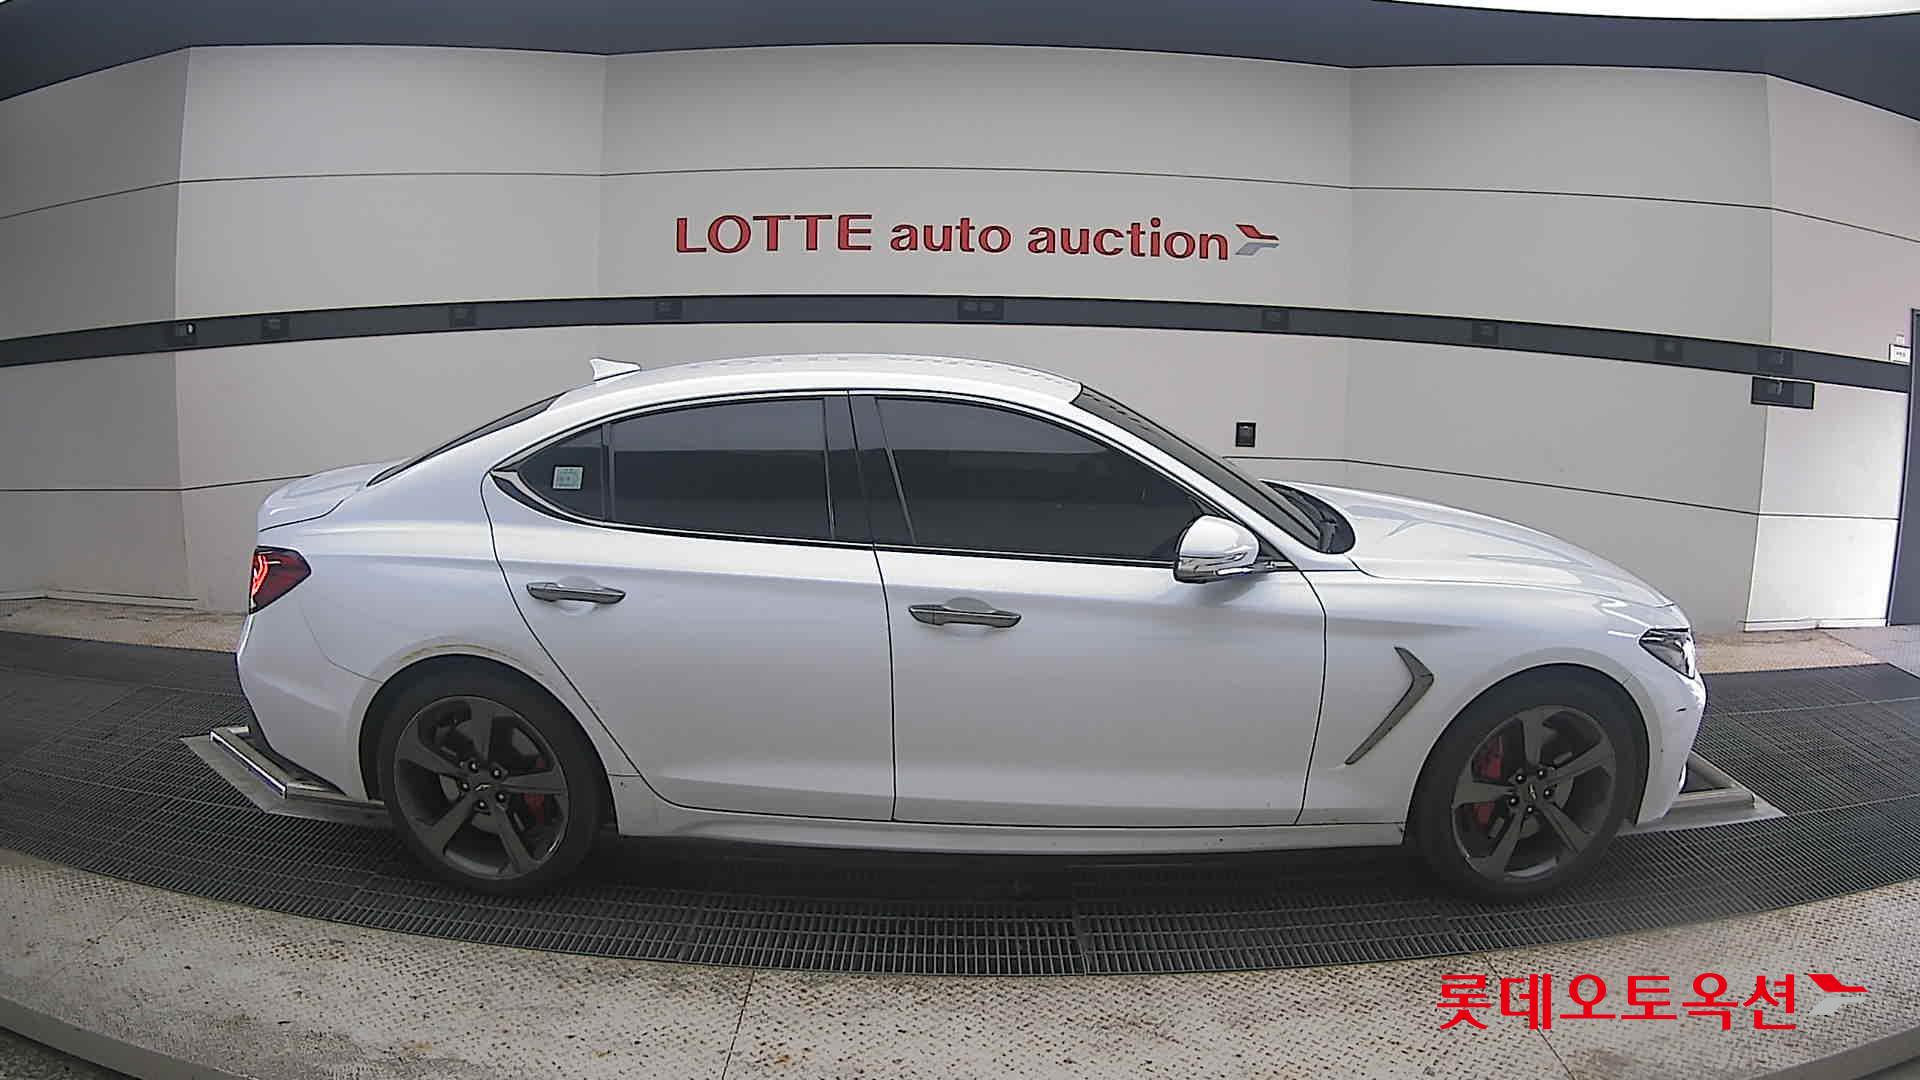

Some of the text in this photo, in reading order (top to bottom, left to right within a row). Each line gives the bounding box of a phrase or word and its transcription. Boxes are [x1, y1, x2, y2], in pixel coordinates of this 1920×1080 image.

[676, 214, 1229, 260] LOTTE auto auction
